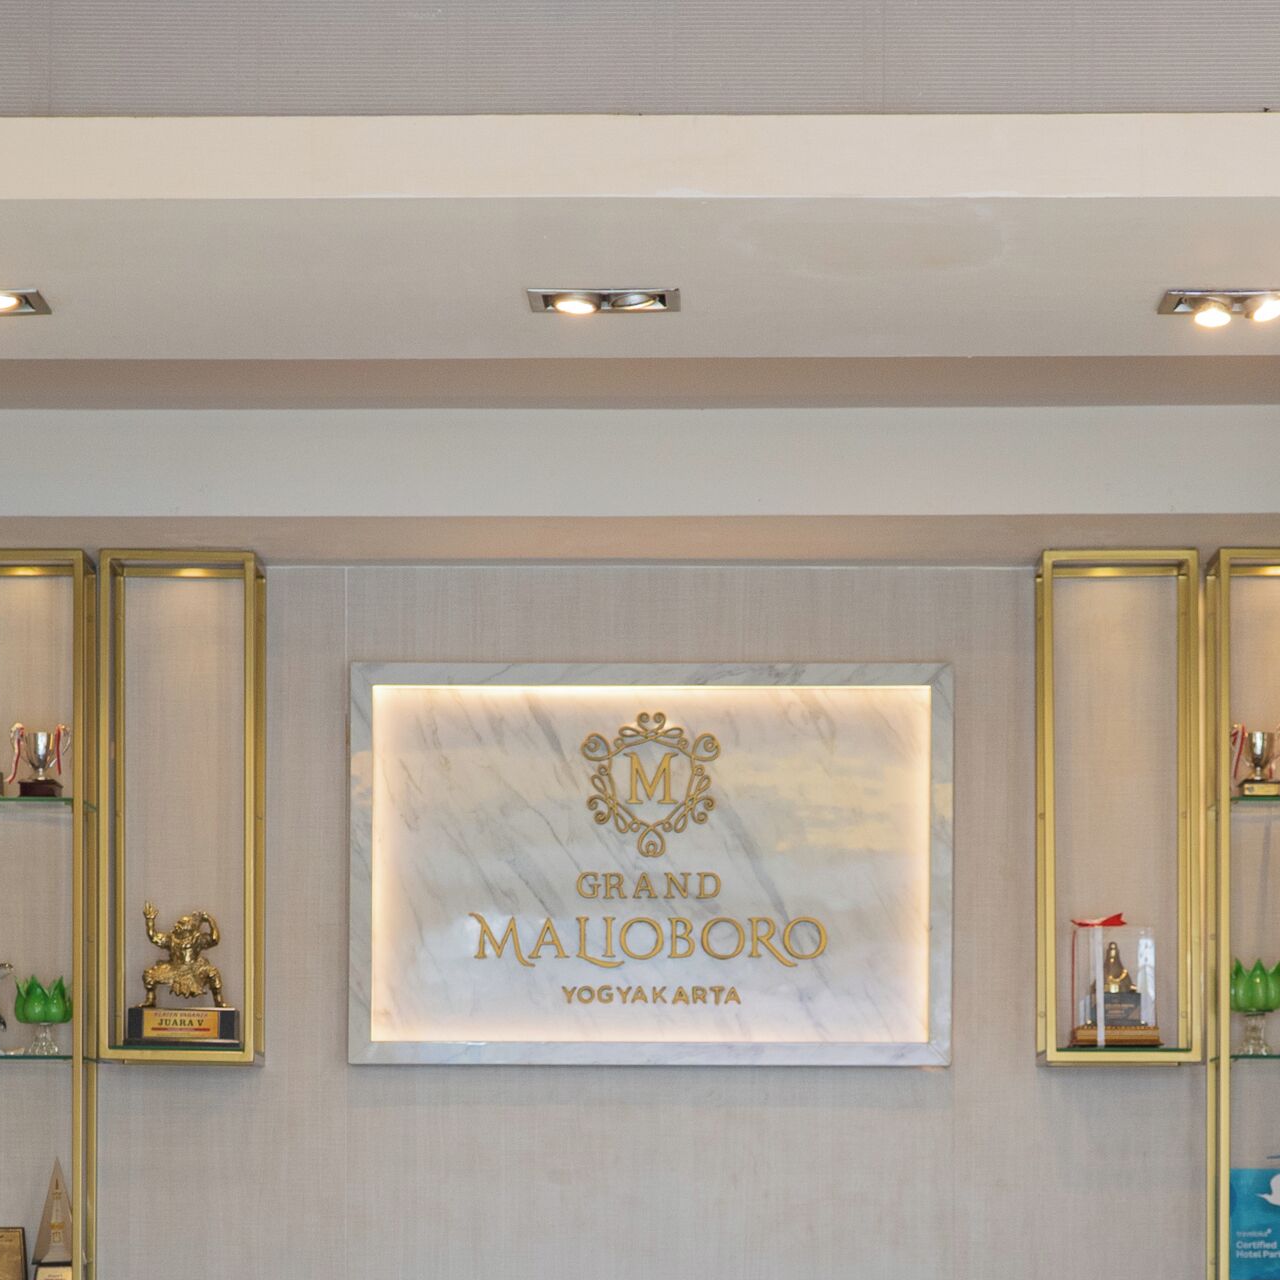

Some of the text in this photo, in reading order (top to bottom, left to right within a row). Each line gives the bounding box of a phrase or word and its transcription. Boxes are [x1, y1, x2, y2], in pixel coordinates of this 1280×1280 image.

[624, 751, 679, 805] M
[577, 871, 721, 899] GRAND
[468, 912, 829, 968] MALIOBORO
[562, 985, 741, 1005] YOGYAKARTA
[158, 1019, 205, 1027] JUARA V
[1236, 1241, 1277, 1249] Certified
